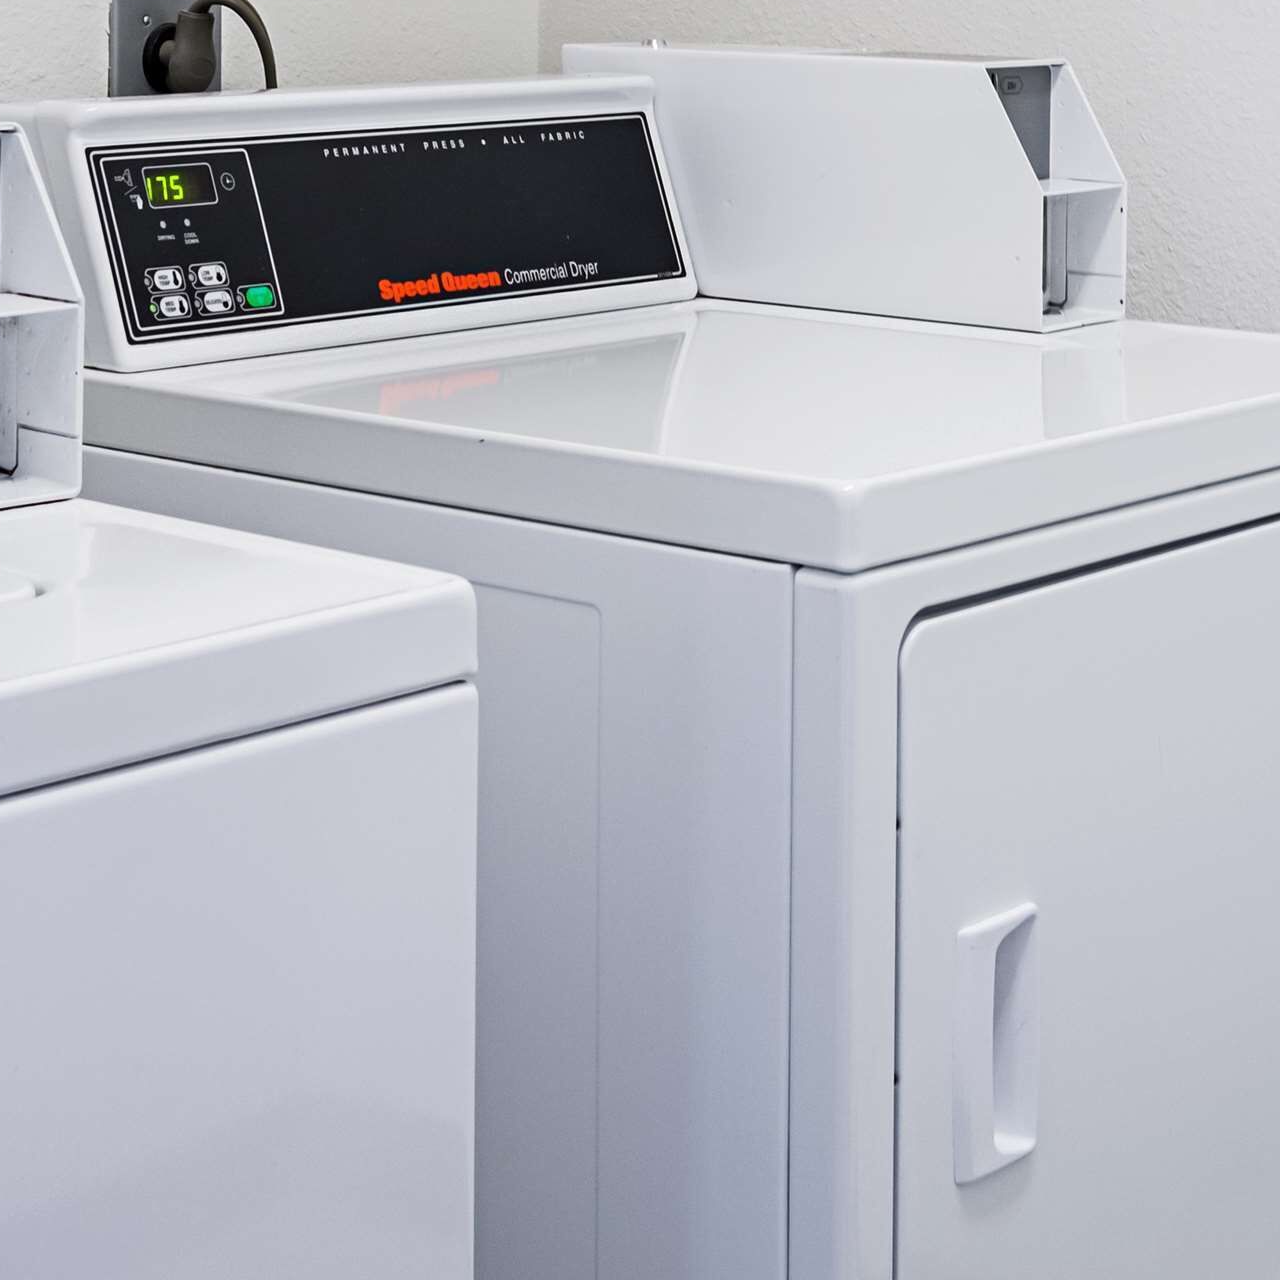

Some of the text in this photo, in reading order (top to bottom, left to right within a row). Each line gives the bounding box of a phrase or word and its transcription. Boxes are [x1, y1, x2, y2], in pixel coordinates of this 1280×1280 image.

[324, 143, 404, 156] PERMANENT
[423, 139, 464, 149] PRESS
[540, 131, 584, 140] FABRIC
[146, 175, 183, 200] 175
[378, 261, 597, 301] Speed Queen Commercial Dryer
